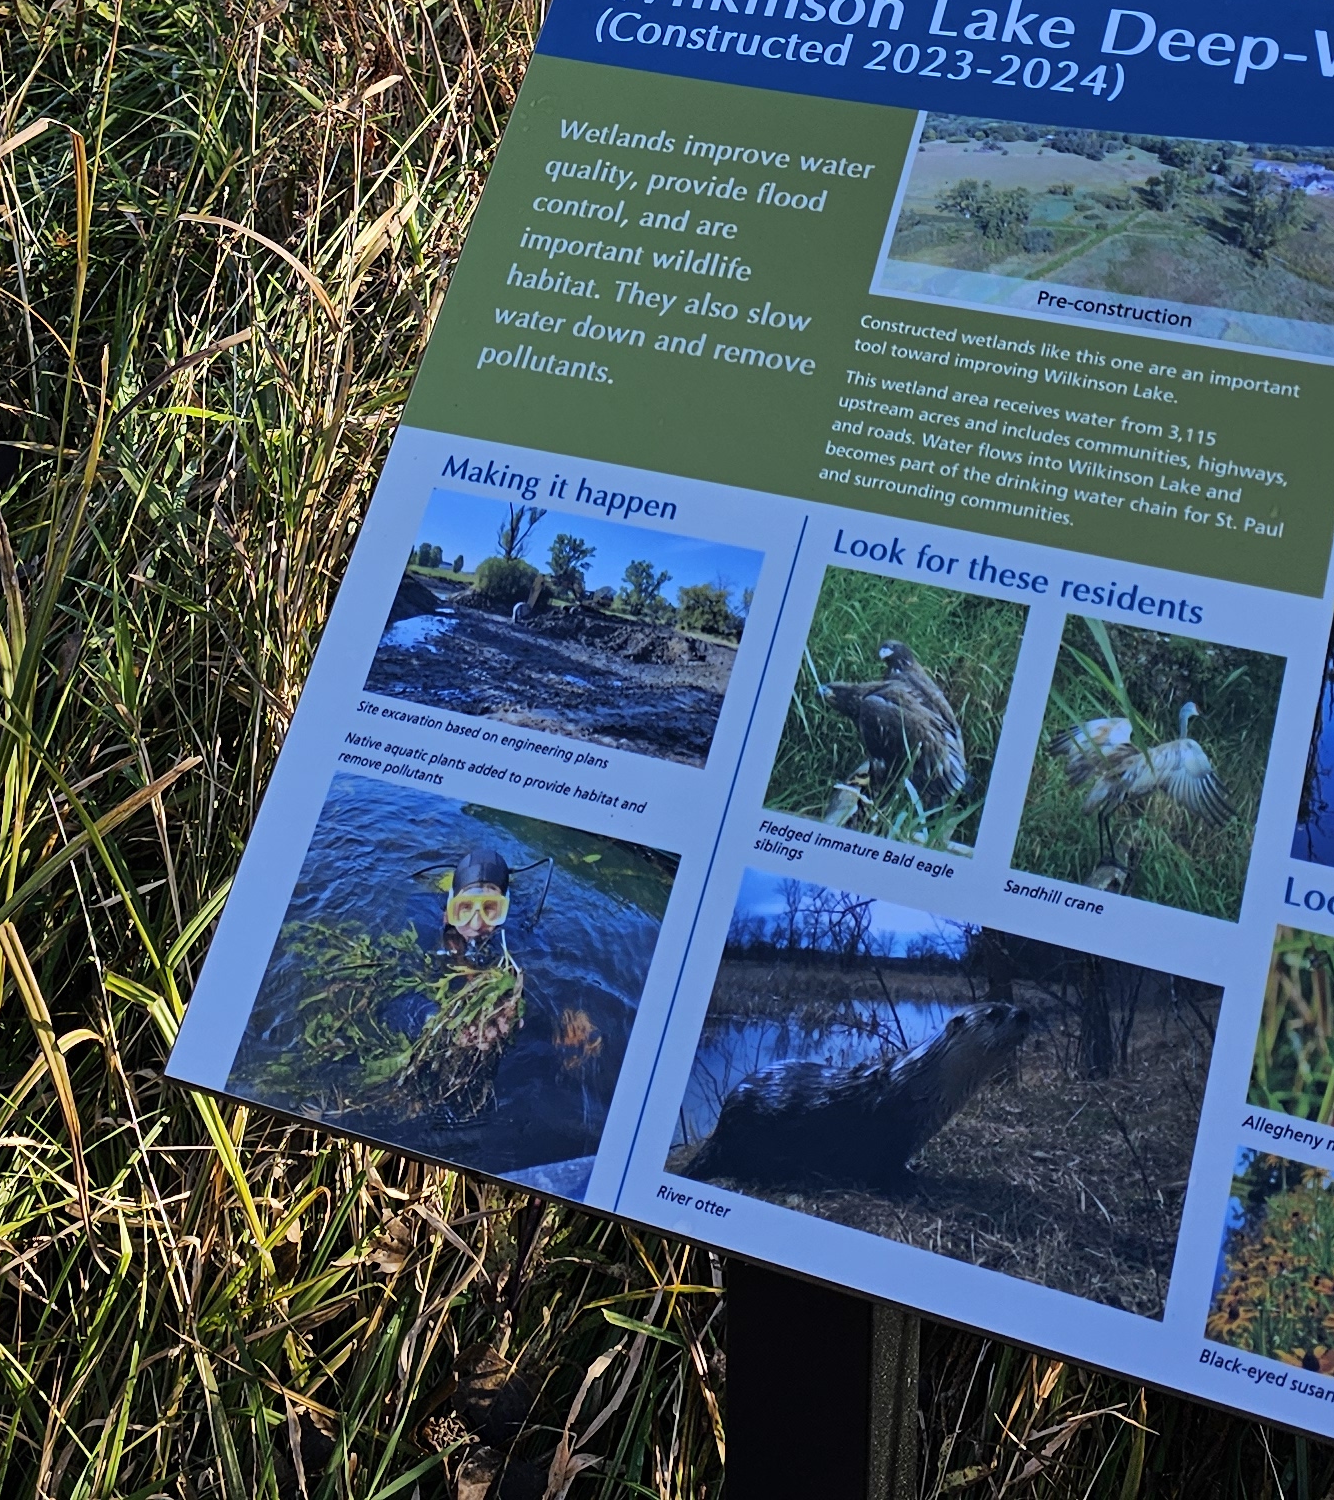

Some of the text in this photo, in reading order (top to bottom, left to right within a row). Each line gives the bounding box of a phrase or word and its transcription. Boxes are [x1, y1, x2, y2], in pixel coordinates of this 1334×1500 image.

[595, 7, 1125, 102] (Constructed 2023-2024)
[561, 119, 876, 179] Wetlands improve water
[545, 158, 828, 212] quality, provide flood
[532, 196, 738, 240] control, and are
[519, 226, 752, 282] important wildlife
[506, 262, 812, 332] habitat. They also slow
[1037, 290, 1192, 328] Pre-construction
[476, 344, 614, 385] pollutants.
[495, 307, 816, 376] water down and remove
[854, 338, 1178, 404] tool toward improving Wilkinson Lake.
[860, 314, 1300, 398] Constructed wetlands like this one are an important
[846, 369, 1217, 447] This wetland area receives water from 3,115
[831, 420, 1242, 503] and roads. Water flows into Wilkinson Lake and
[838, 396, 1287, 487] upstream acres and includes communities, highways,
[441, 455, 677, 520] Making it happen
[818, 468, 1074, 526] and surrounding communities.
[825, 440, 1284, 538] becomes part of the drinking water chain for St. Paul
[833, 529, 1204, 624] Look for these residents
[356, 700, 609, 769] Site excavation based on engineering plans
[753, 838, 804, 861] siblings
[758, 820, 954, 878] Fledged immature Bald eagle
[1003, 879, 1104, 915] Sandhill crane
[1241, 1115, 1324, 1150] Allegheny
[656, 1185, 731, 1218] River otter
[1199, 1348, 1289, 1387] Black-eyed
